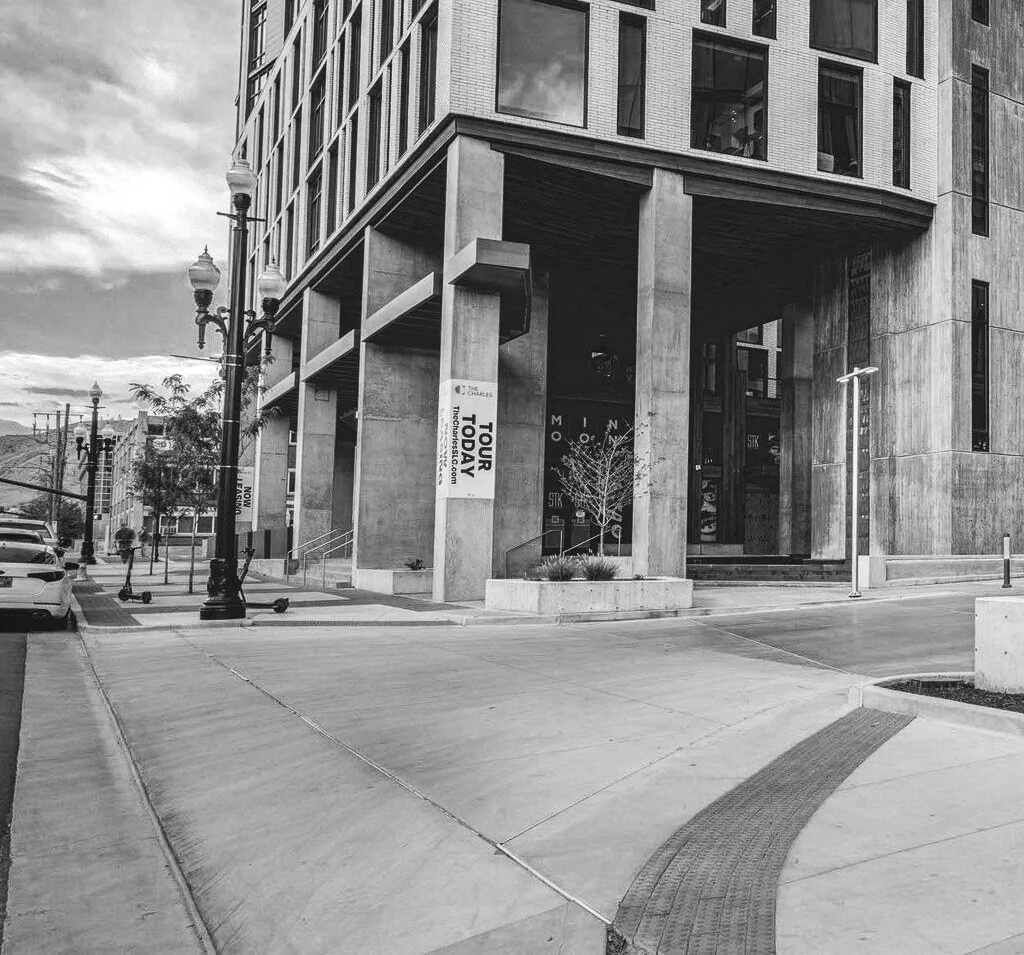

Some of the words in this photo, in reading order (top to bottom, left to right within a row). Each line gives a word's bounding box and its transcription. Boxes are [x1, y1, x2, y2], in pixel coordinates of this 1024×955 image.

[467, 390, 493, 398] CHARLES
[450, 405, 460, 485] TheCharlesSLC.com
[460, 413, 476, 479] TODAY
[477, 421, 493, 472] TOUR
[746, 434, 760, 449] STK
[235, 478, 243, 515] LEASING
[243, 485, 252, 509] NOW
[548, 492, 563, 508] STK
